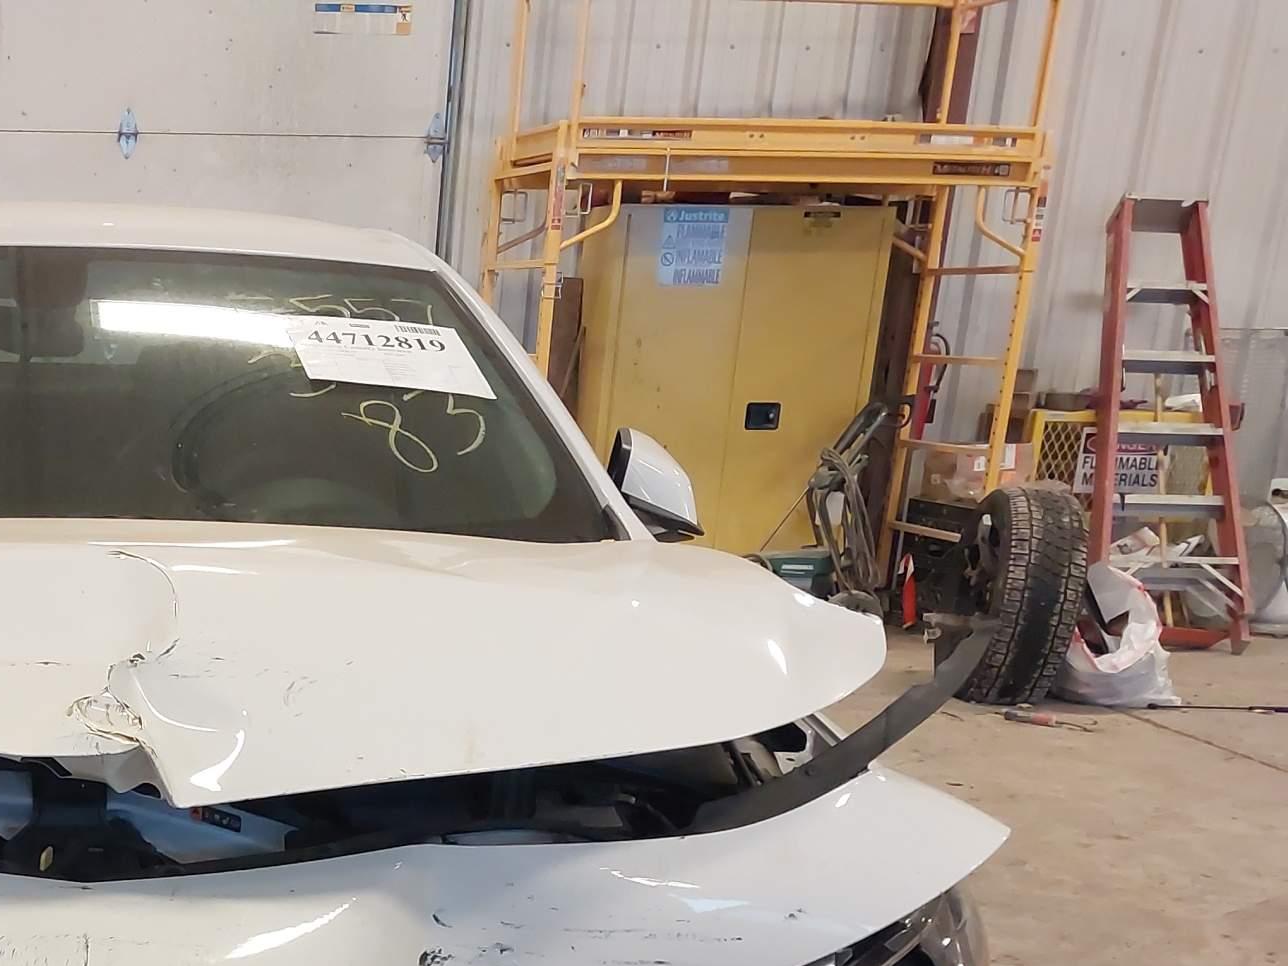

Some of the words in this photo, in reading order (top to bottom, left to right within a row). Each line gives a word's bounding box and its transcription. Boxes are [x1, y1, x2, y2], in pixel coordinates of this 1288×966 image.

[679, 210, 725, 221] Justrite
[307, 330, 446, 352] 44712819
[1082, 455, 1159, 471] FLMABL
[1081, 472, 1159, 488] MERIALS
